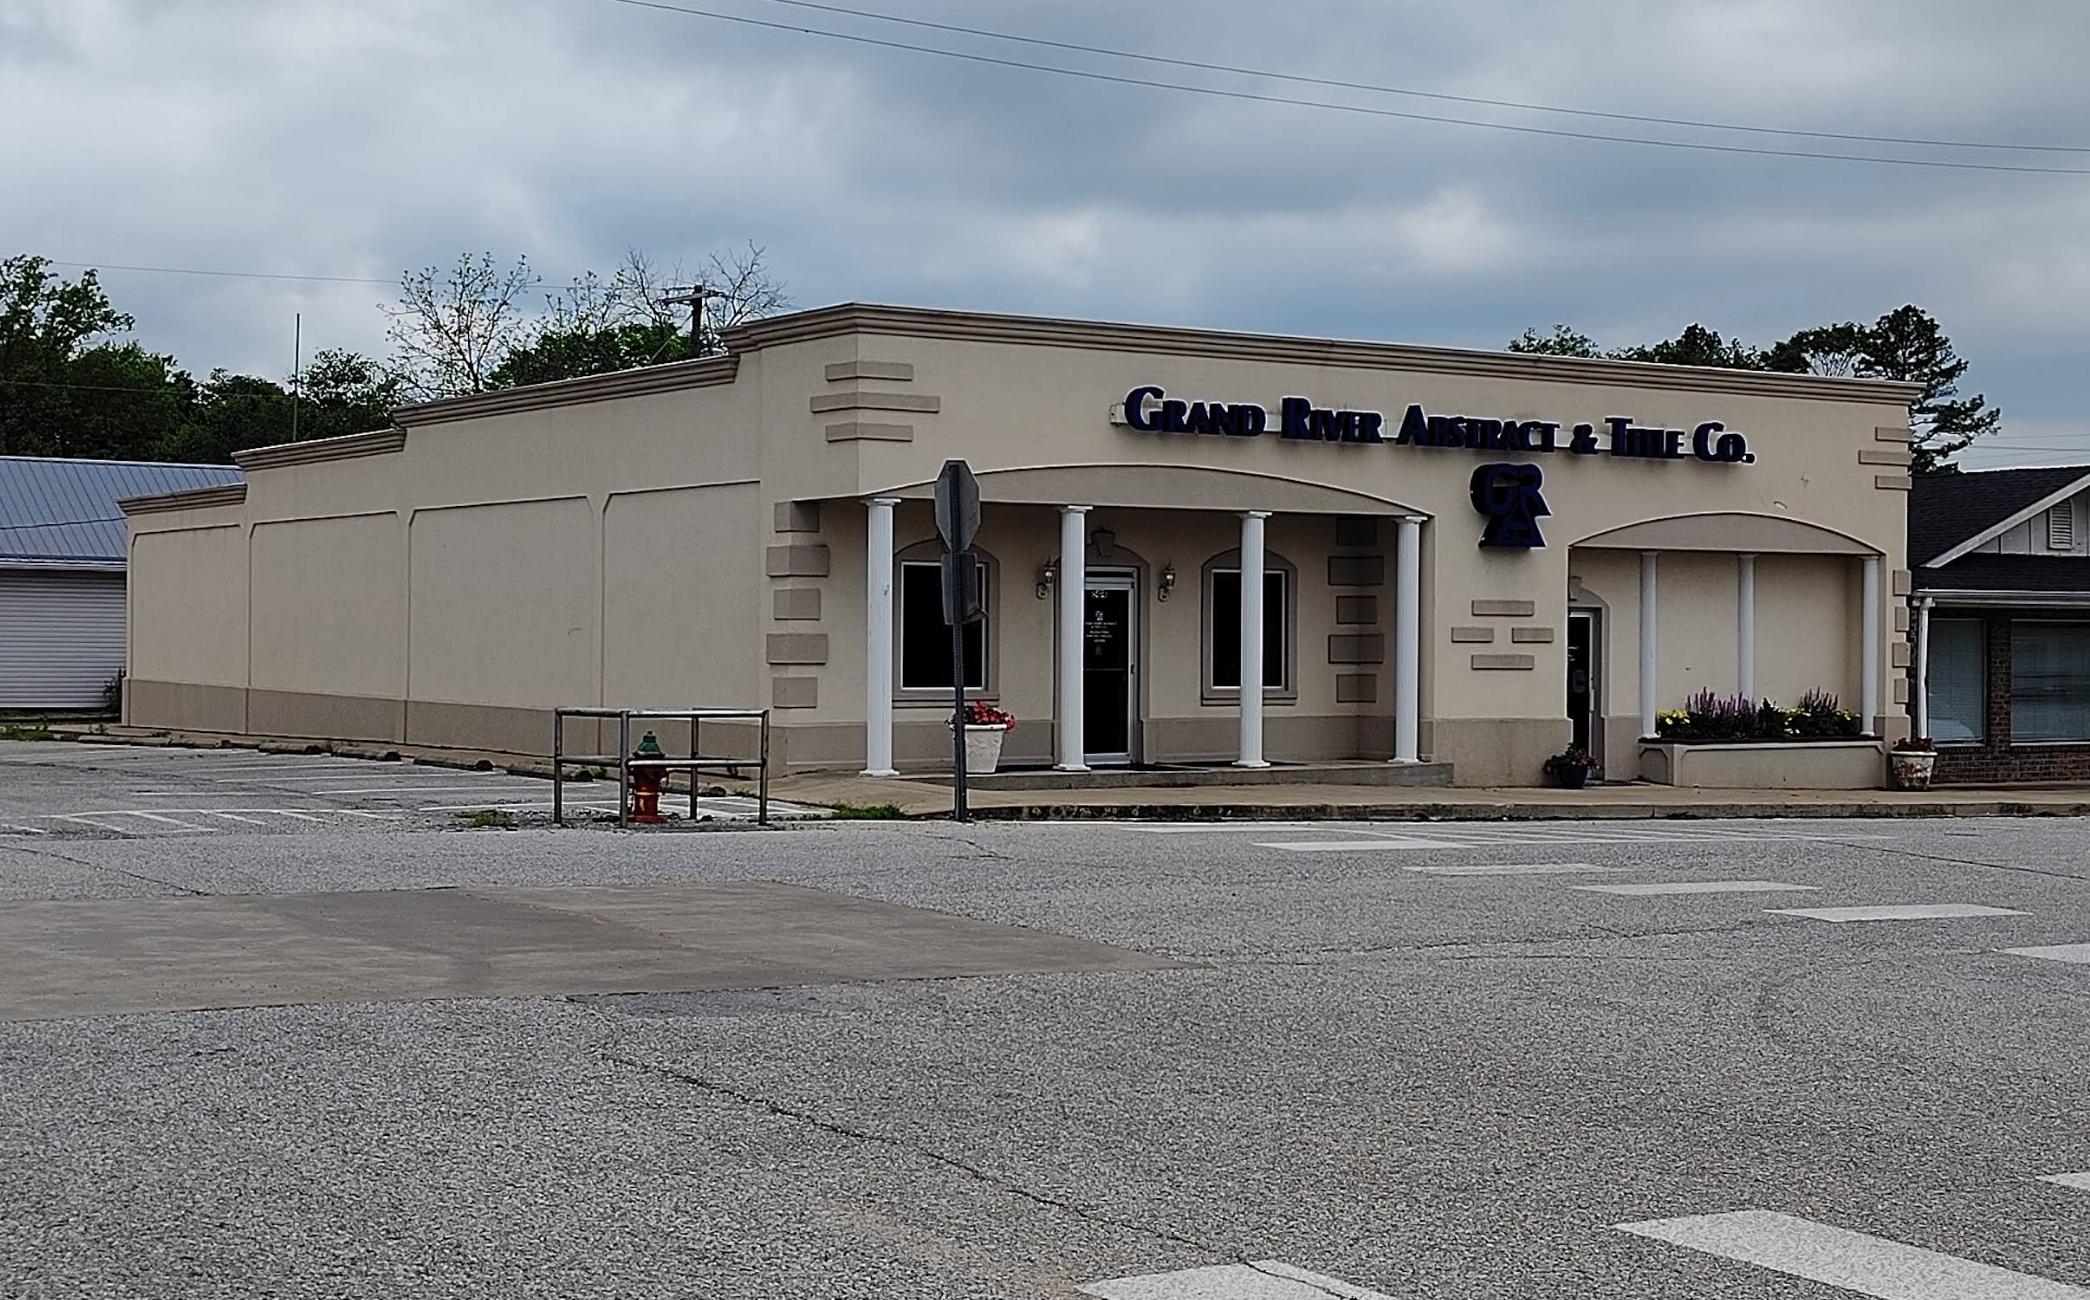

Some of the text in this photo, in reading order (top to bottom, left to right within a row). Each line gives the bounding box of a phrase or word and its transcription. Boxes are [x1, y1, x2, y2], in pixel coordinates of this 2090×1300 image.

[1124, 386, 1755, 464] GRAND RIVER ABSTRACT & TITLE CO.
